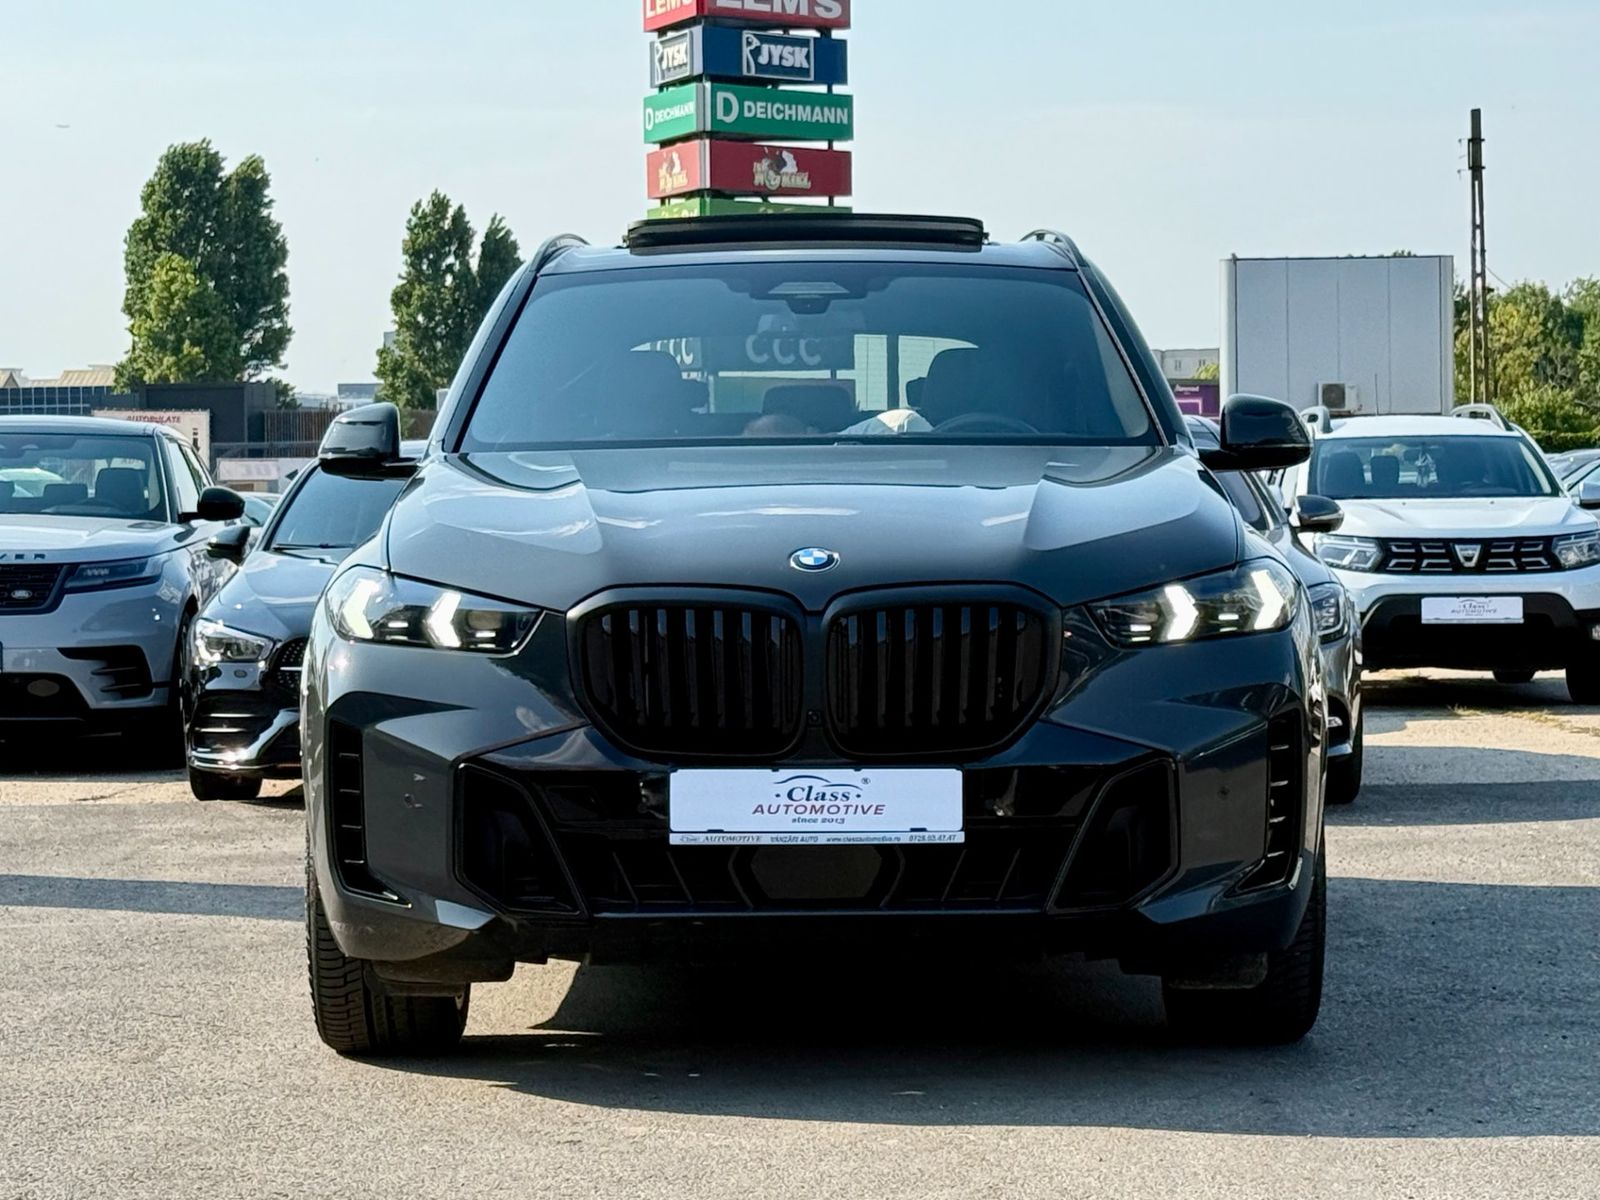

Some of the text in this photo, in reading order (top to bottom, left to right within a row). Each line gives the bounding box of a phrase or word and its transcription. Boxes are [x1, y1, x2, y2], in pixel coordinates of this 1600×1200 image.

[661, 42, 687, 69] JYSK
[757, 43, 810, 69] JYSK
[655, 101, 695, 123] DEICHMANN
[743, 100, 848, 125] DEICHMANN
[786, 785, 851, 802] Class
[752, 804, 886, 815] AUTOMOTIVE
[821, 817, 845, 825] 2013
[703, 835, 761, 843] AUTOMOTIVE
